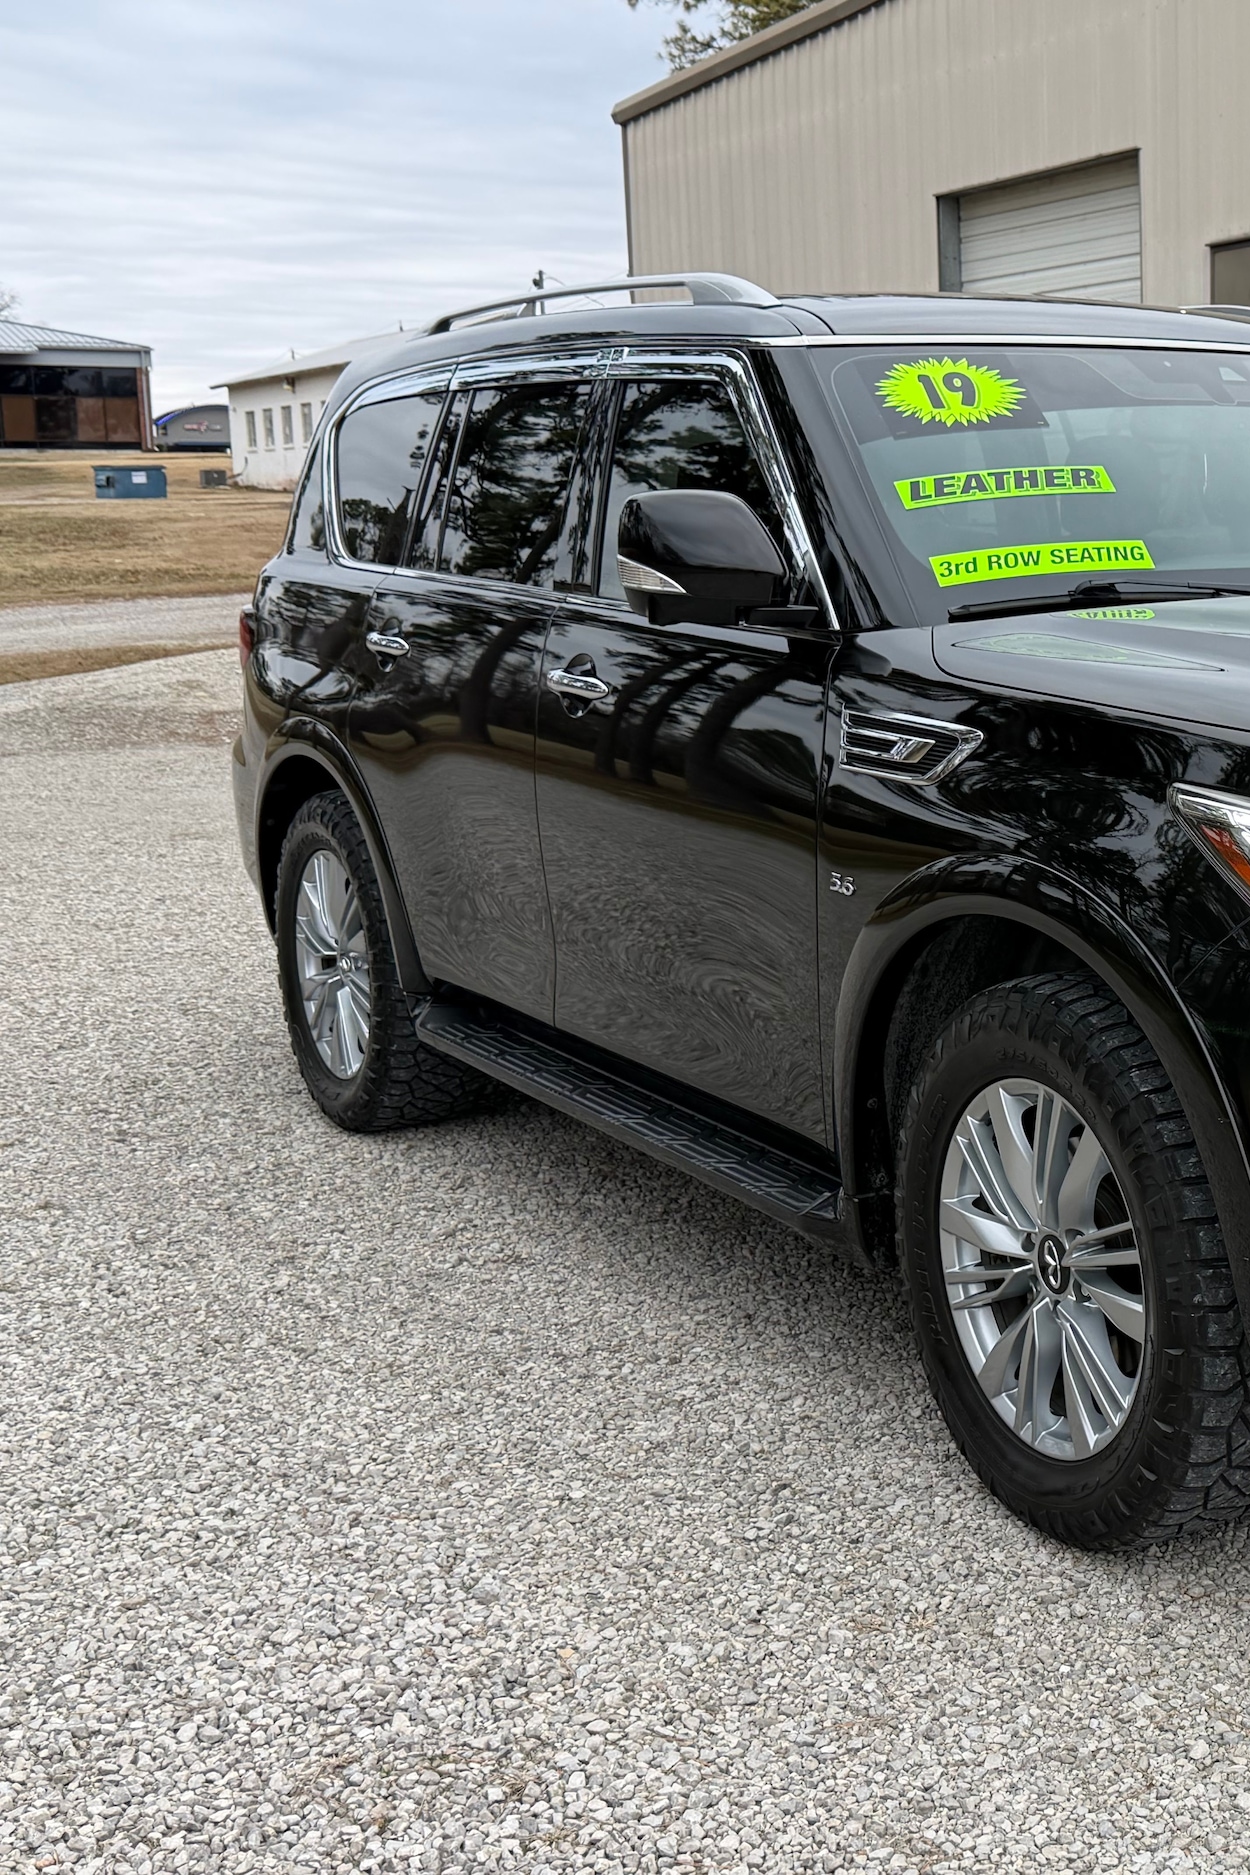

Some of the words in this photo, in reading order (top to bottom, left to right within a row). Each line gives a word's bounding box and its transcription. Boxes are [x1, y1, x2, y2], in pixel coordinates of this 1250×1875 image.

[917, 371, 981, 410] 19
[909, 468, 1103, 504] LEATHER
[939, 557, 978, 579] 3rd
[987, 551, 1041, 571] ROW
[1050, 545, 1145, 565] SEATING
